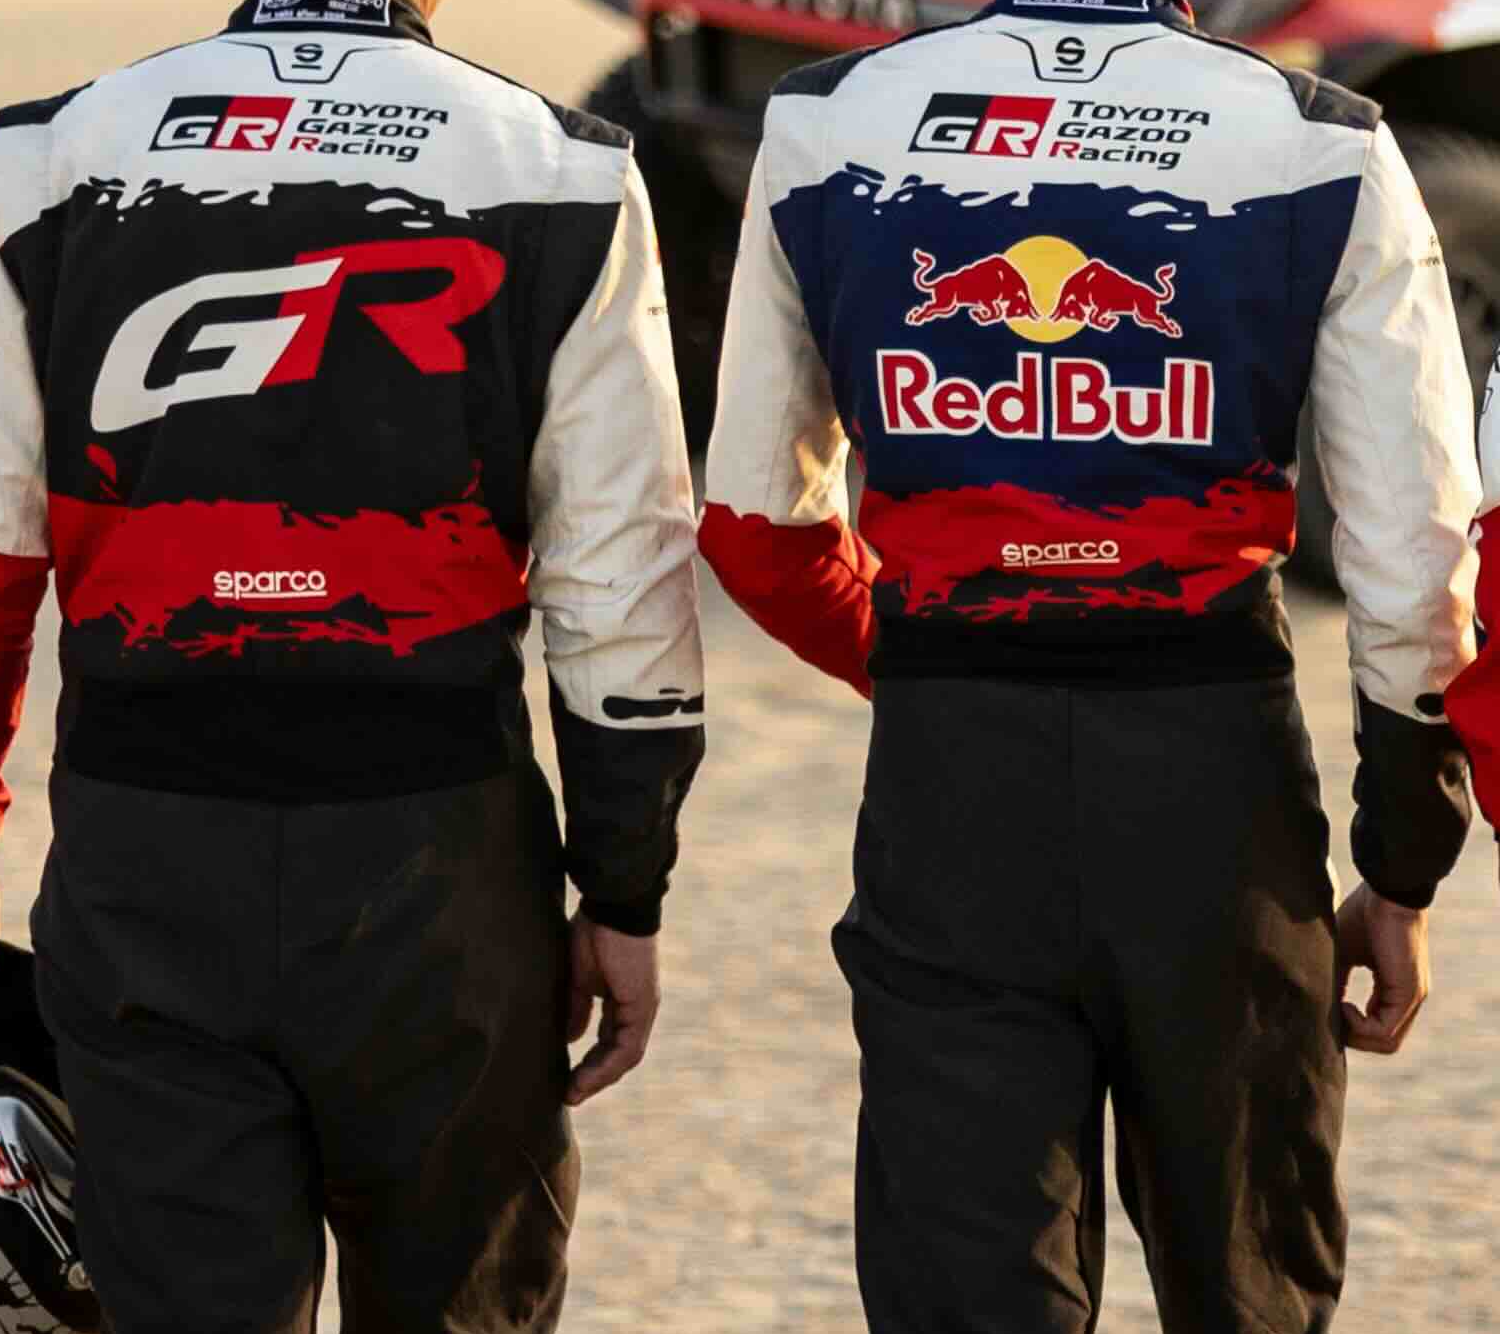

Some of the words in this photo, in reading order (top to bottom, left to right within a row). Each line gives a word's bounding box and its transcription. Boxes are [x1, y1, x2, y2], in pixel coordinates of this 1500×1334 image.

[307, 99, 449, 124] TOYOTA
[1068, 100, 1211, 126] TOYOTA
[155, 116, 279, 149] GR
[297, 118, 429, 139] GAZOO
[915, 116, 1040, 156] GR
[1057, 122, 1192, 144] GAZOO
[288, 136, 419, 163] Racing
[1049, 141, 1181, 170] Racing
[90, 237, 506, 433] GR
[876, 349, 1043, 440] Red
[1051, 357, 1214, 446] Bull
[1001, 540, 1120, 567] sparco
[213, 570, 327, 599] sparco
